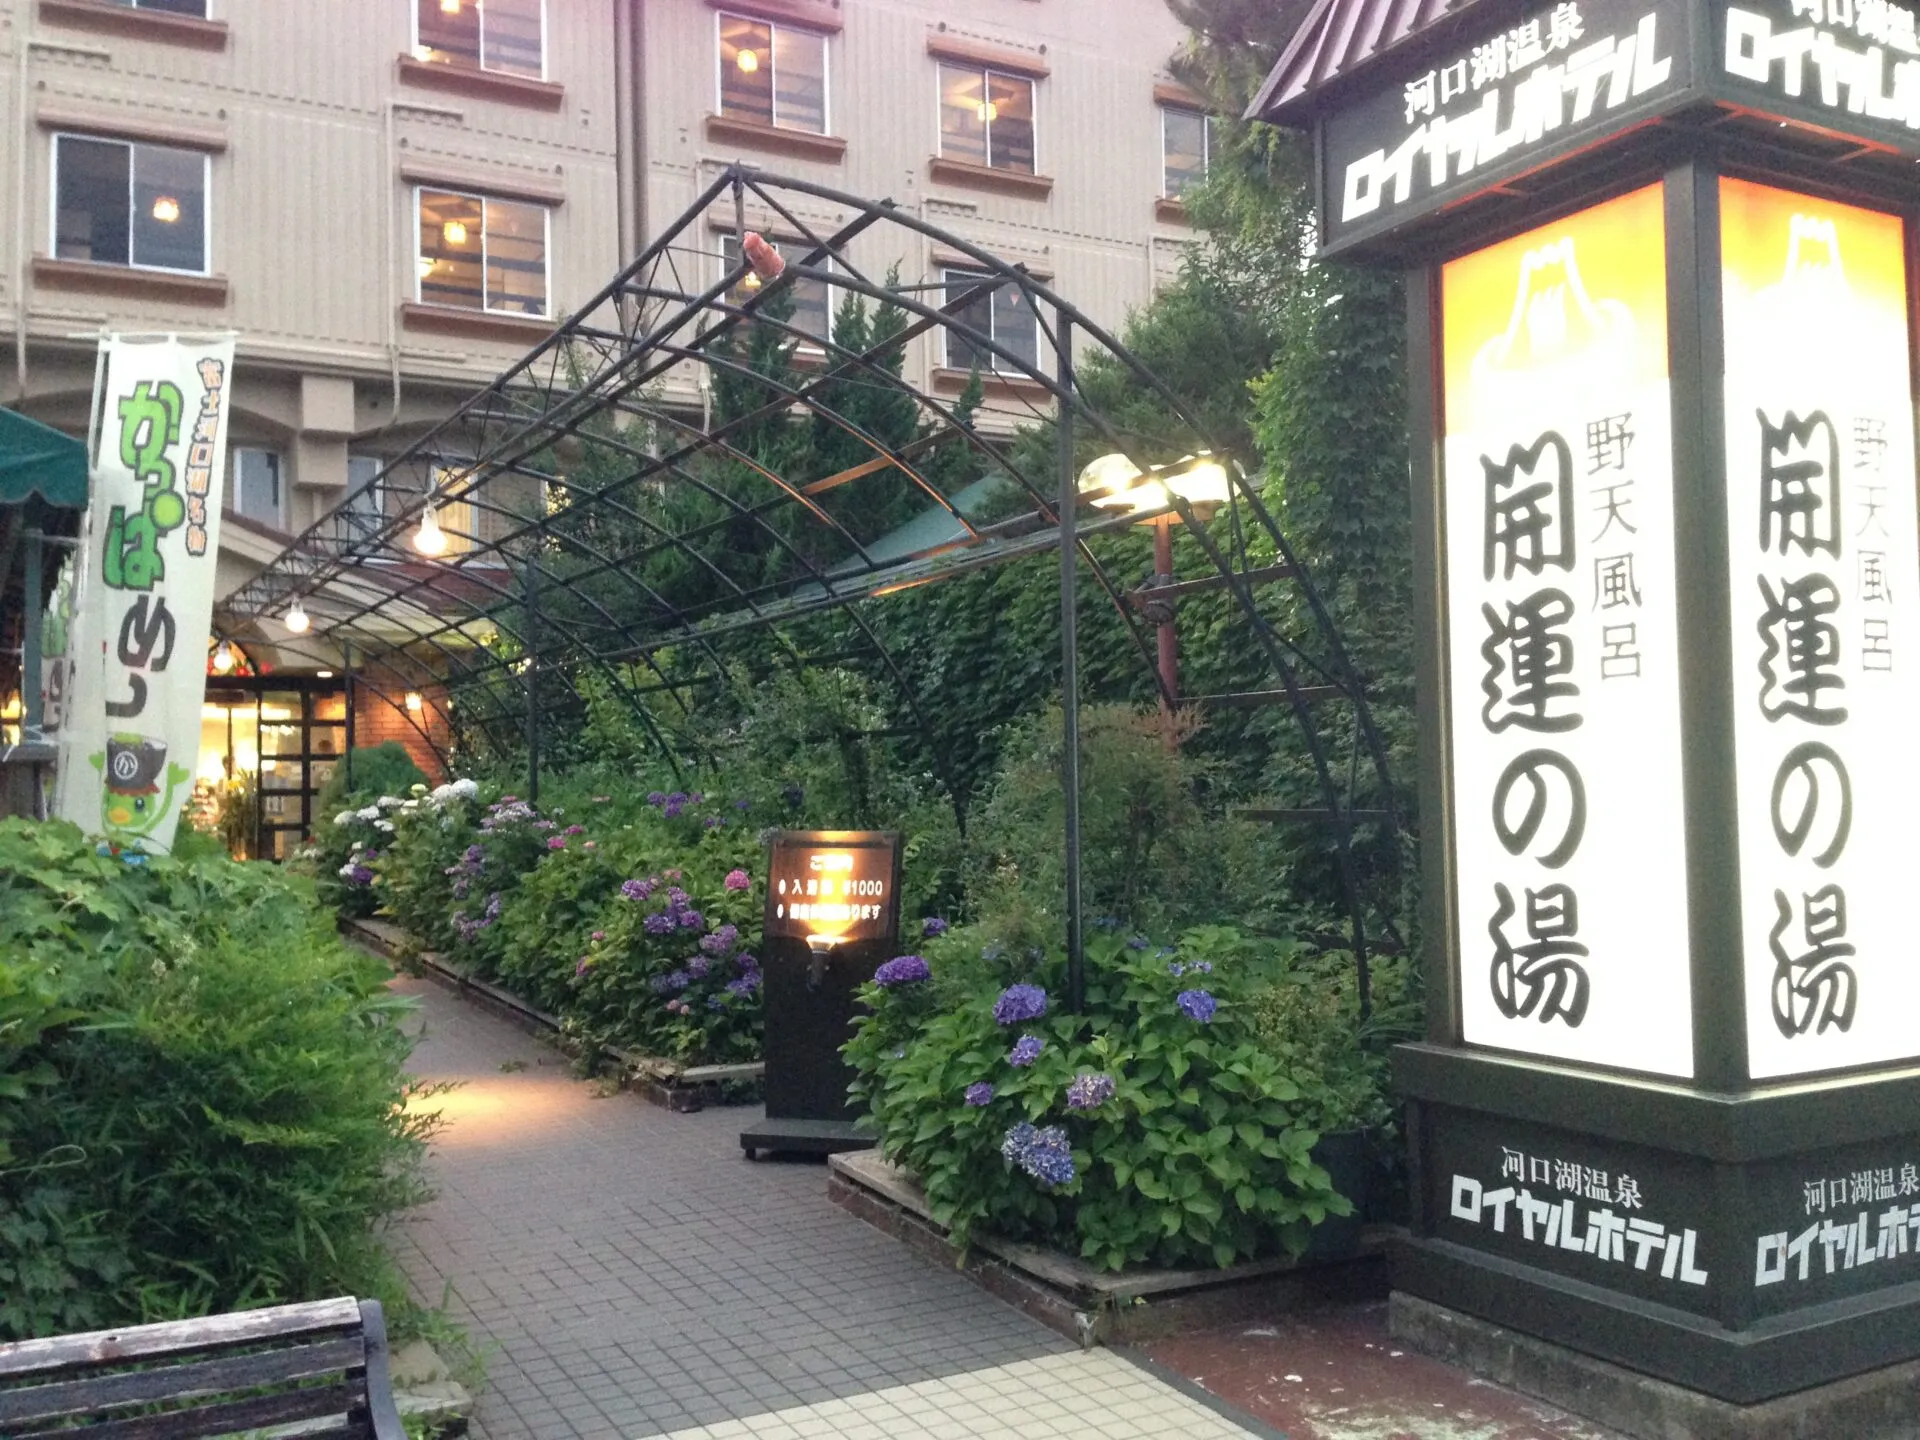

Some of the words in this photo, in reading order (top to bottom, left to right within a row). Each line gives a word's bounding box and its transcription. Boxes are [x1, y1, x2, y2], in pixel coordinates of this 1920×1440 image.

[1341, 12, 1672, 223] ロイヤルホテル
[1404, 2, 1585, 123] 河口湖温泉
[1586, 411, 1643, 680] 野天風呂
[1853, 416, 1893, 672] 野天風呂
[1479, 430, 1591, 1028] 開運の湯
[1756, 407, 1858, 1039] 開運の湯
[1451, 1174, 1708, 1286] ロイヤルホテル
[1501, 1146, 1643, 1209] 河口湖温泉
[1803, 1163, 1920, 1215] 河口湖温泉
